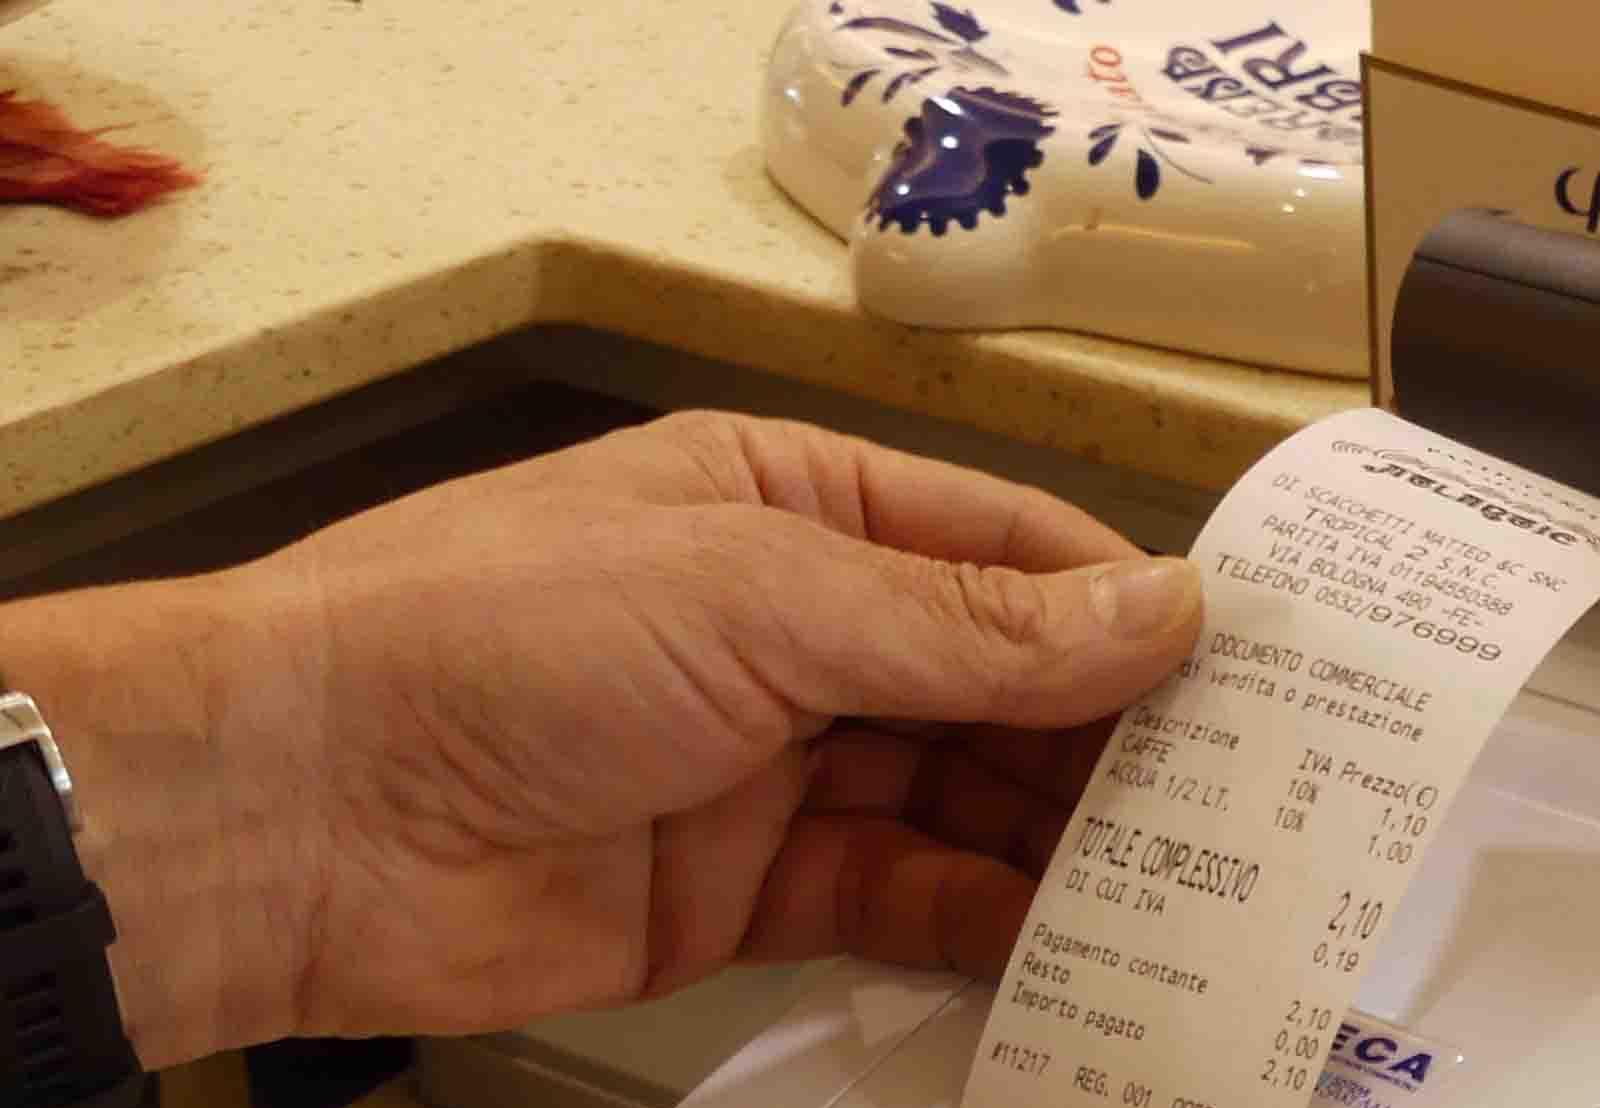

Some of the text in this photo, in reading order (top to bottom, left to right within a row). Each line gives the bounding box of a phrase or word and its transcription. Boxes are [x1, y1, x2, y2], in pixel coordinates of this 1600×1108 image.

[1263, 515, 1339, 553] PARTITA
[1346, 545, 1383, 567] IVA
[1265, 543, 1303, 563] VIA
[1308, 558, 1388, 595] BOLOGNA
[1273, 473, 1296, 492] DI
[1304, 484, 1413, 536] SCACCHETTI
[1424, 531, 1490, 563] MATTEO
[1528, 571, 1567, 592] SNC
[1304, 508, 1396, 551] TROPICAL
[1406, 546, 1431, 562] 2
[1216, 554, 1503, 662] TELEFONO 0532/976999
[1209, 668, 1277, 699] vendita
[1285, 688, 1297, 703] o
[1304, 691, 1425, 741] prestazione
[1210, 633, 1432, 712] DOCUMENTO COMMERCIALE
[1106, 760, 1158, 789] ACQUA
[1164, 775, 1195, 800] 1/2
[1273, 806, 1305, 832] 10%
[1288, 779, 1320, 804] 10%
[1298, 748, 1332, 776] IVA
[1073, 816, 1384, 940] TOTALE COMPLESSIVO 2,10
[1066, 868, 1360, 973] DI CUI IVA 0,19
[1021, 951, 1320, 1060] Resto 0,00
[1031, 922, 1332, 1031] Pagamento contante 2,10
[991, 1040, 1050, 1075] #11217
[1073, 1066, 1109, 1097] REG.
[1010, 979, 1079, 1022] Importo
[1083, 1006, 1145, 1040] pagato
[1259, 1059, 1307, 1090] 2,10
